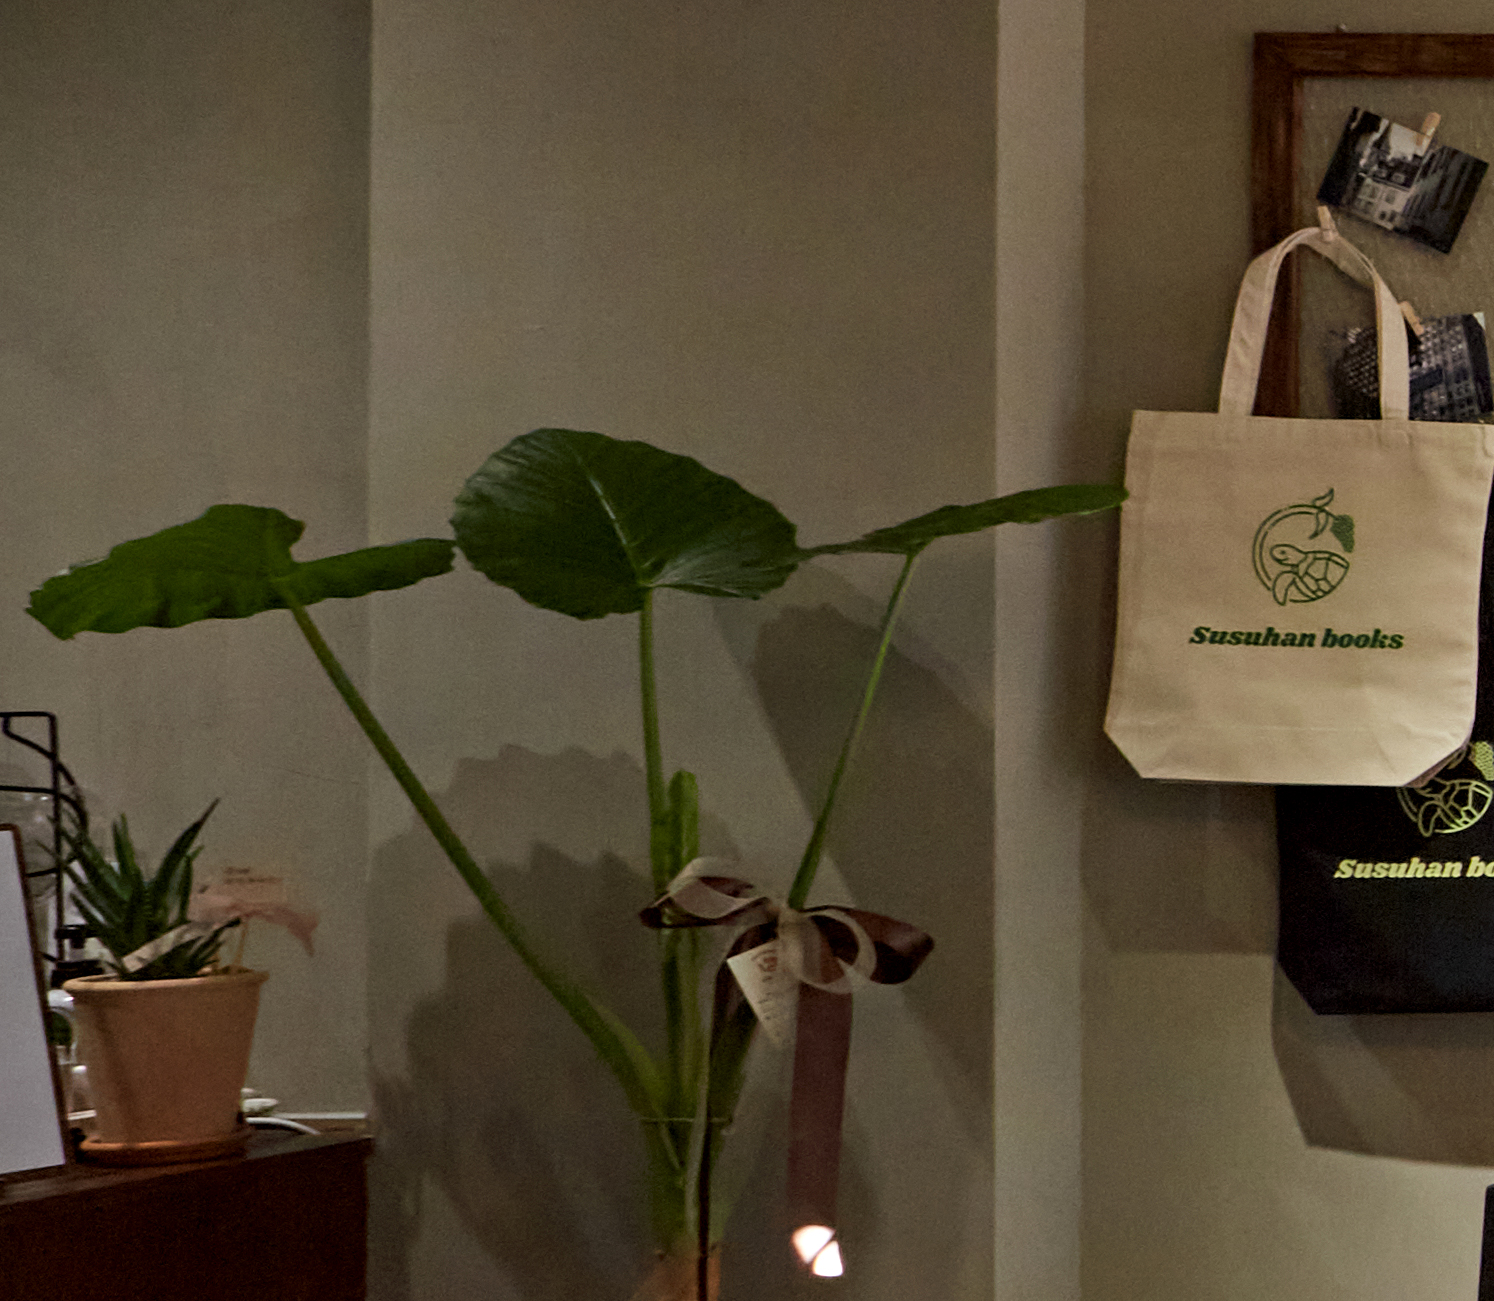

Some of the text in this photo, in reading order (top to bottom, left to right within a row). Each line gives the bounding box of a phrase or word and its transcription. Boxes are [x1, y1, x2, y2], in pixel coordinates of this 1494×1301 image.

[1187, 626, 1405, 650] Susuhan books
[1332, 857, 1464, 879] Susuhan
